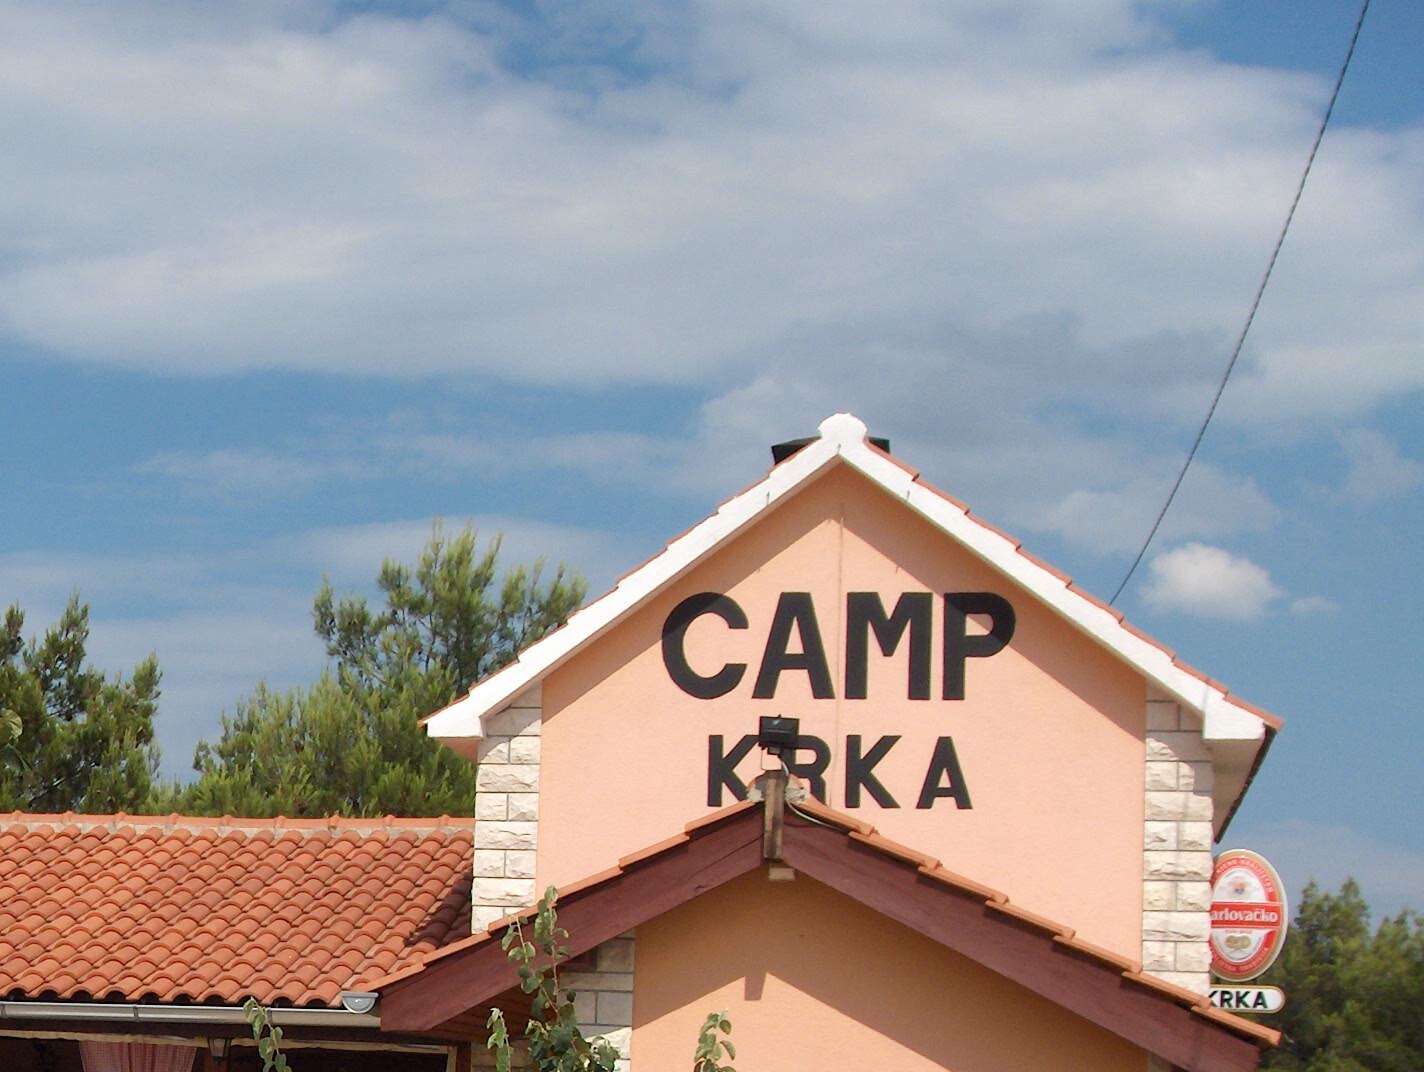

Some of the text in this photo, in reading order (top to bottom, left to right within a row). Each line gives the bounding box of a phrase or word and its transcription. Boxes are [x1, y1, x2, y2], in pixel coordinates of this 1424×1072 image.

[662, 592, 1016, 701] CAMP
[707, 734, 974, 810] KRKA
[1210, 908, 1279, 922] arlovačko
